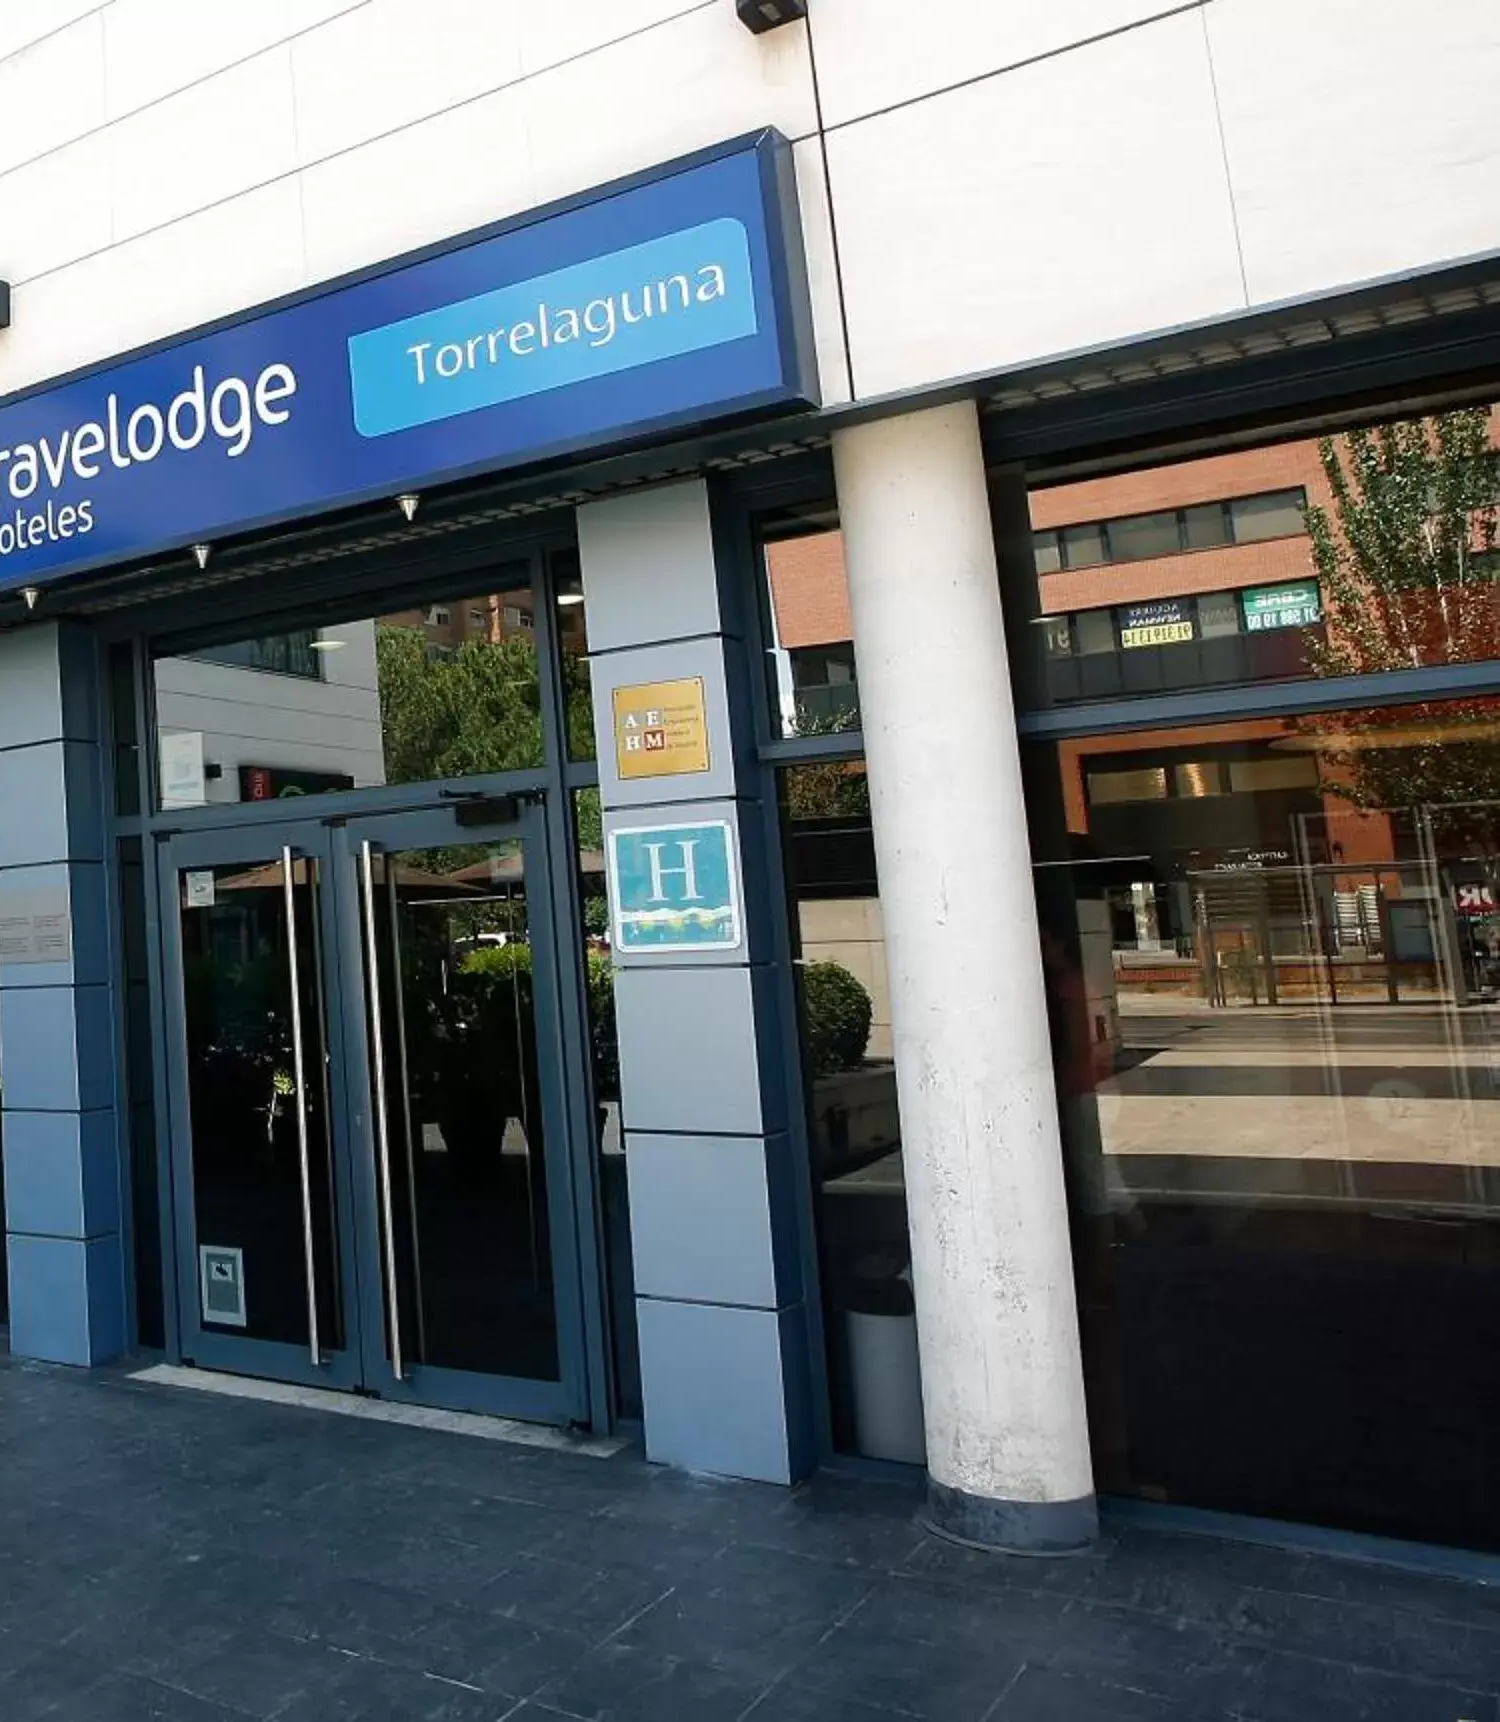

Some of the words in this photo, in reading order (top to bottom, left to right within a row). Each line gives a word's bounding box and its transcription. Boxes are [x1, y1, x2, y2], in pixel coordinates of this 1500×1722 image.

[407, 263, 726, 385] Torrelaguna
[624, 712, 639, 729] A
[646, 711, 660, 726] E
[625, 735, 640, 750] H
[646, 732, 663, 748] M
[641, 839, 705, 903] H
